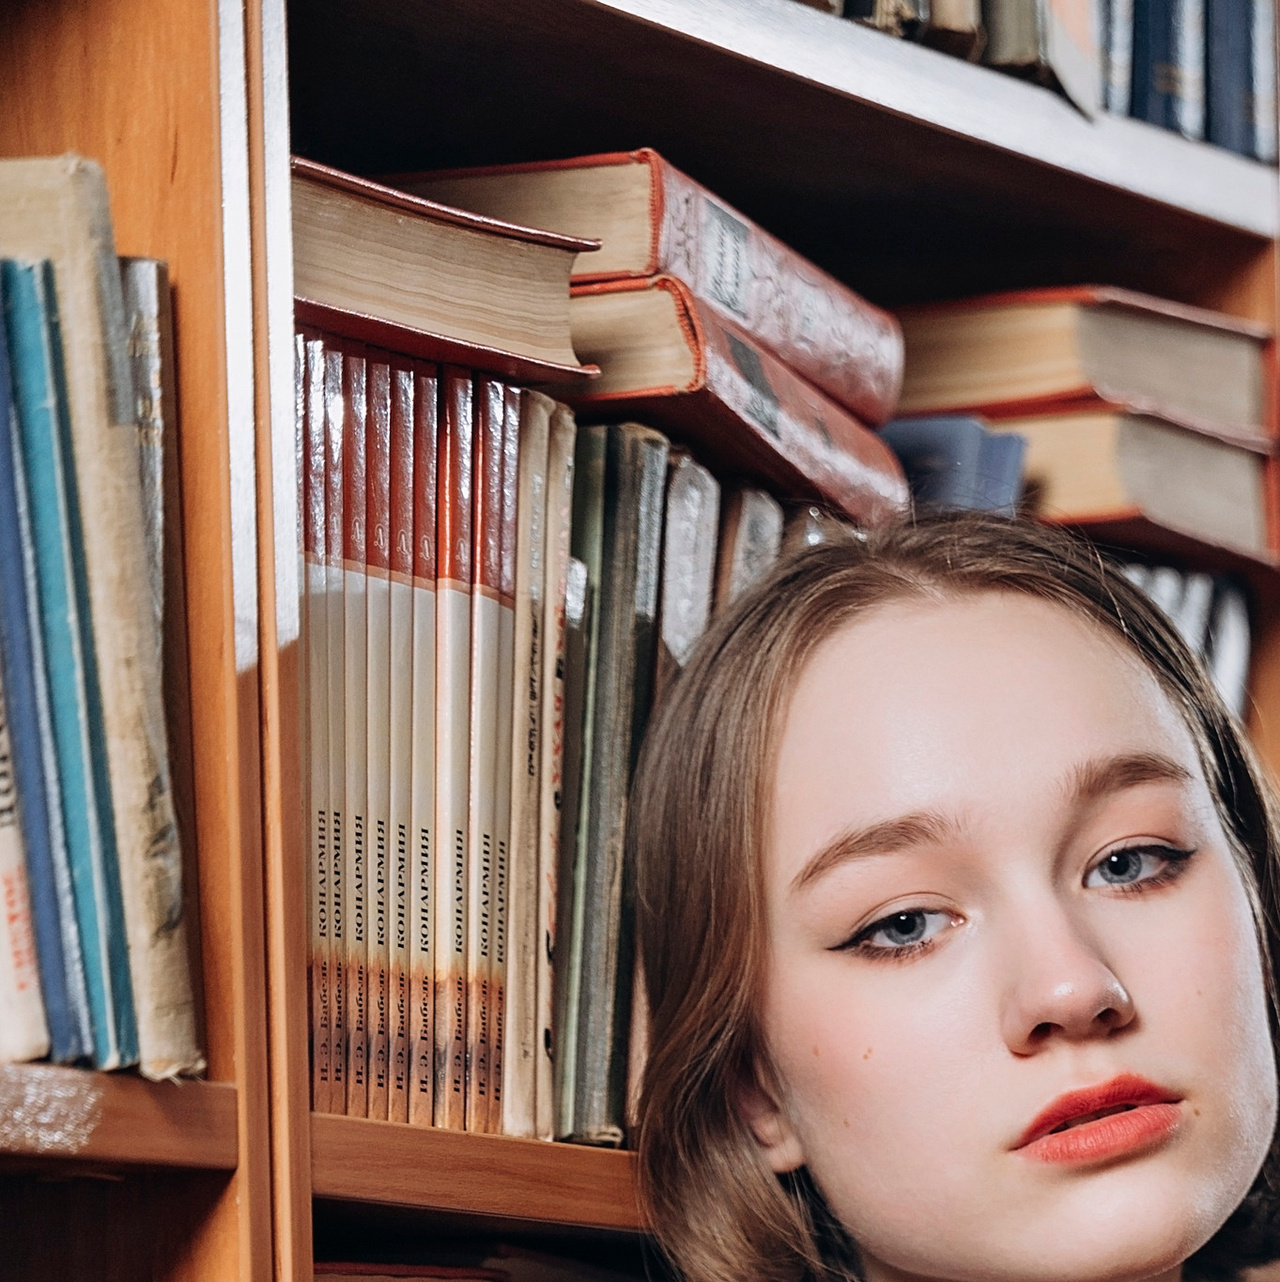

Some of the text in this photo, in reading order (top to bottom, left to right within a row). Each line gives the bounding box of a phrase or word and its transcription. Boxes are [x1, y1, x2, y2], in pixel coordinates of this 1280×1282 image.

[317, 810, 327, 938] КОНАРМИЯ
[333, 811, 342, 939] КОНАРМИЯ
[355, 815, 363, 942] КОНАРМИЯ
[377, 819, 385, 946] КОНАРМИЯ
[398, 823, 406, 949] КОНАРМИЯ
[421, 827, 429, 953] КОНАРМИЯ
[455, 829, 463, 954] КОНАРМИЯ
[481, 833, 490, 957] КОНАРМИЯ
[319, 961, 329, 1030] Бабель
[334, 961, 342, 1030] Бабель
[355, 965, 364, 1032] Бабель
[377, 969, 385, 1036] Бабель
[397, 972, 405, 1038] Бабель
[420, 975, 429, 1042] Бабель
[454, 976, 463, 1042] Бабель
[480, 980, 488, 1045] Бабель
[320, 1064, 329, 1082] И.
[334, 1064, 342, 1082] И.
[355, 1067, 363, 1085] И.
[377, 1070, 384, 1088] И.
[397, 1071, 404, 1090] И.
[420, 1075, 428, 1093] И.
[454, 1075, 461, 1093] И.
[479, 1078, 486, 1096] И.
